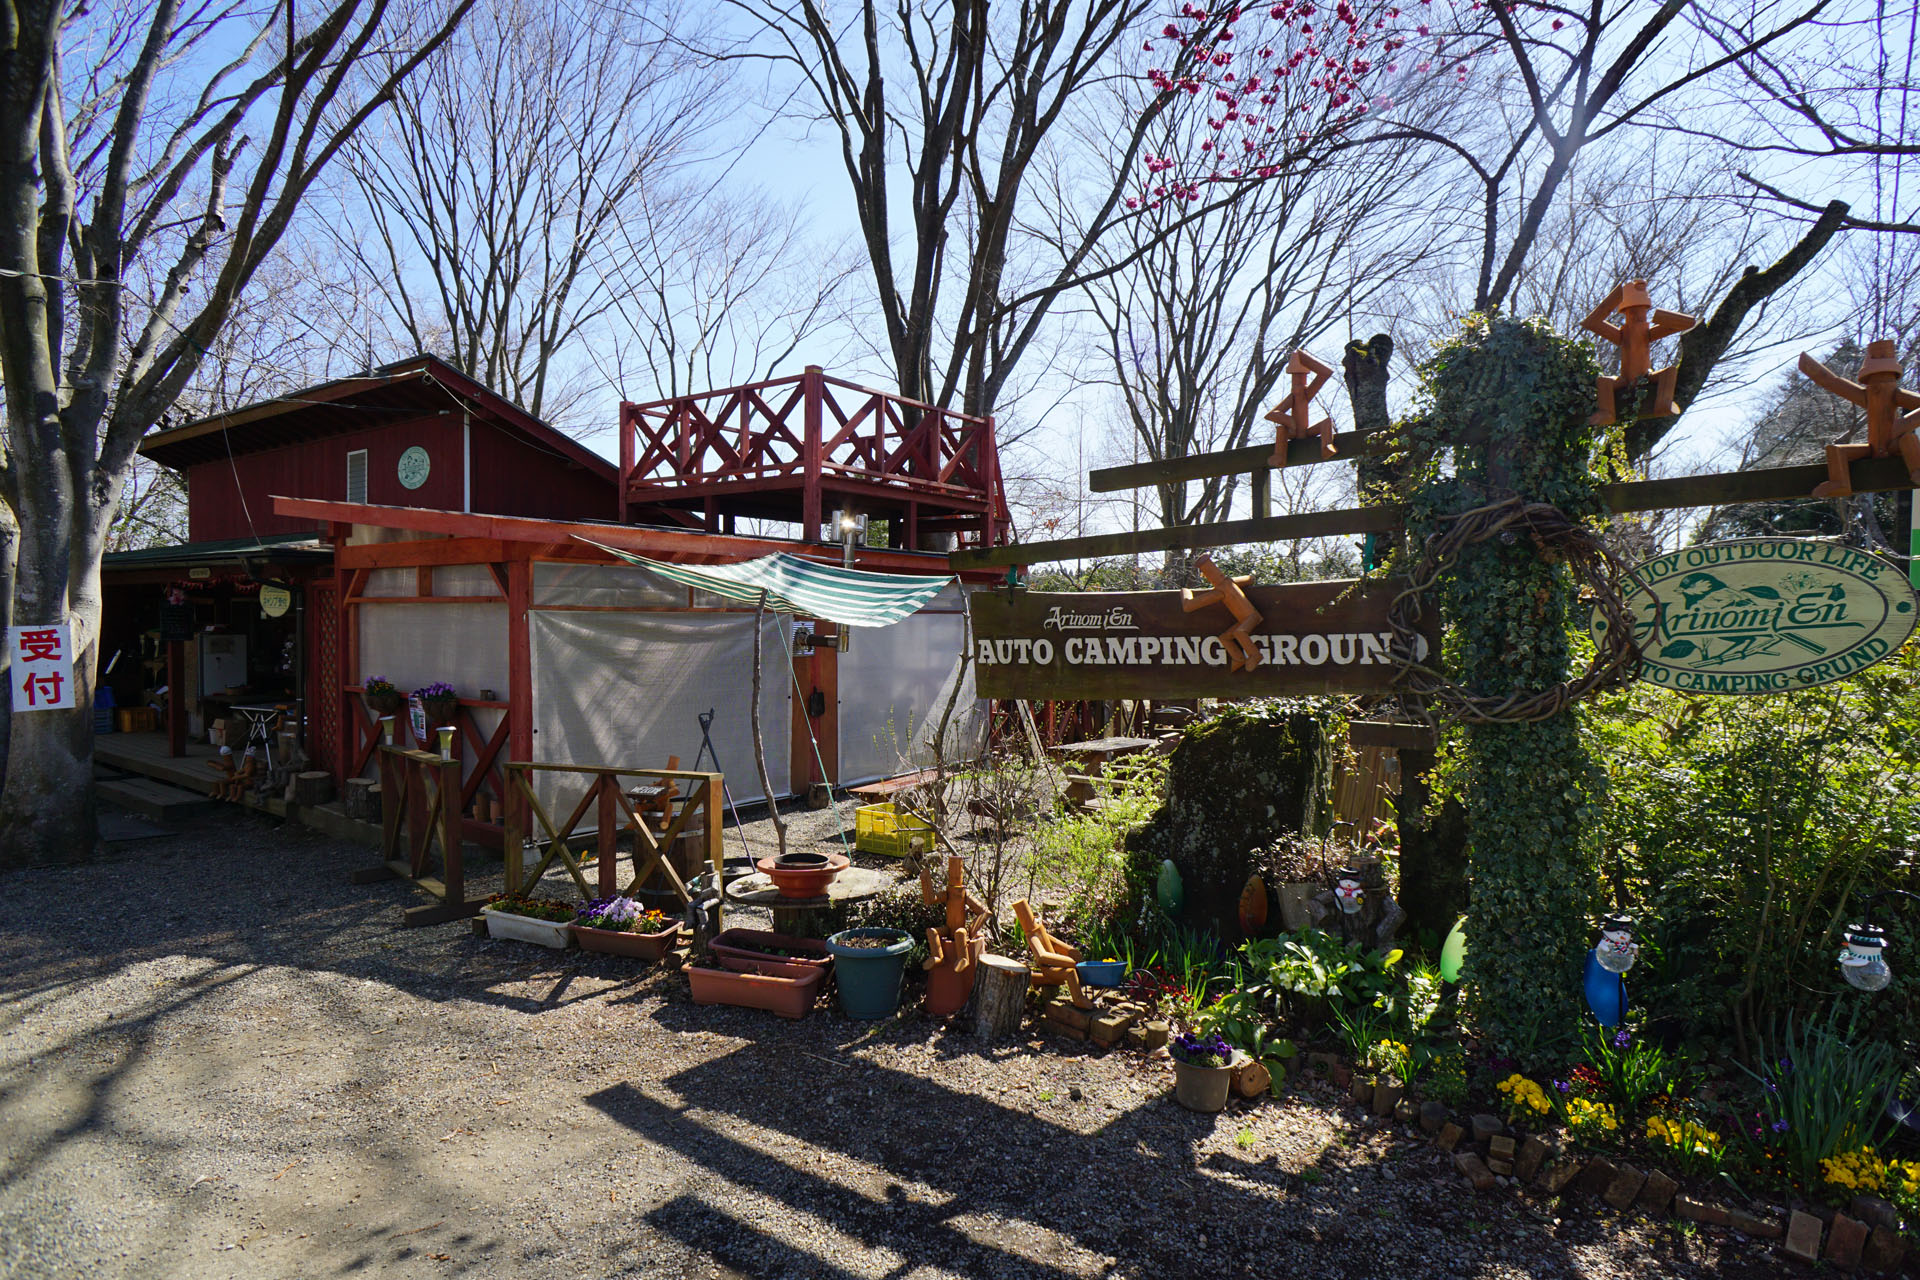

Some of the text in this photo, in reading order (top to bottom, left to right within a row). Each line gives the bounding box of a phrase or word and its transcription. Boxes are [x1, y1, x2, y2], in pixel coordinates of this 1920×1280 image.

[1686, 541, 1817, 567] OUTDOOR
[1820, 545, 1887, 581] LIFE
[19, 628, 65, 706] 受付
[977, 638, 1054, 665] AUTO
[1064, 635, 1228, 665] CAMPING
[1675, 671, 1791, 693] CAMPING
[1796, 637, 1889, 685] GRUND
